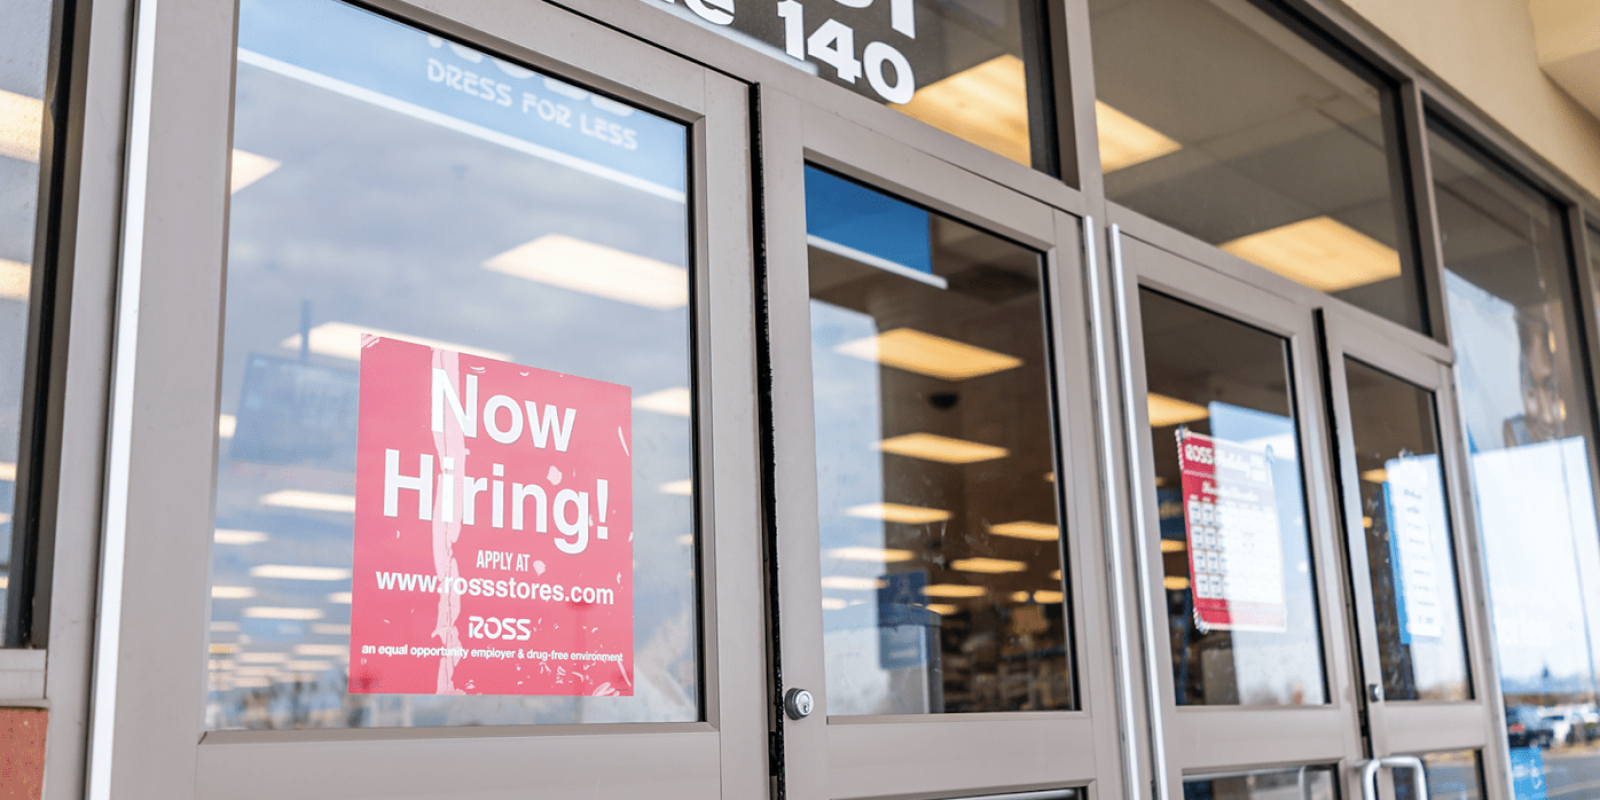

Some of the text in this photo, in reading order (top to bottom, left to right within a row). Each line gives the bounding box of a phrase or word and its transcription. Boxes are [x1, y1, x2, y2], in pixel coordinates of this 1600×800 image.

[777, 0, 915, 104] 140
[428, 58, 512, 107] DRESS
[523, 92, 571, 129] FOR
[580, 113, 638, 151] LESS
[431, 367, 576, 452] Now
[383, 448, 609, 555] Hiring!
[375, 571, 614, 605] www.rossstores.com
[476, 550, 530, 572] APPLY AT
[361, 644, 624, 662] an equal opportunity employer & drug-free environment
[468, 615, 532, 641] ROSS
